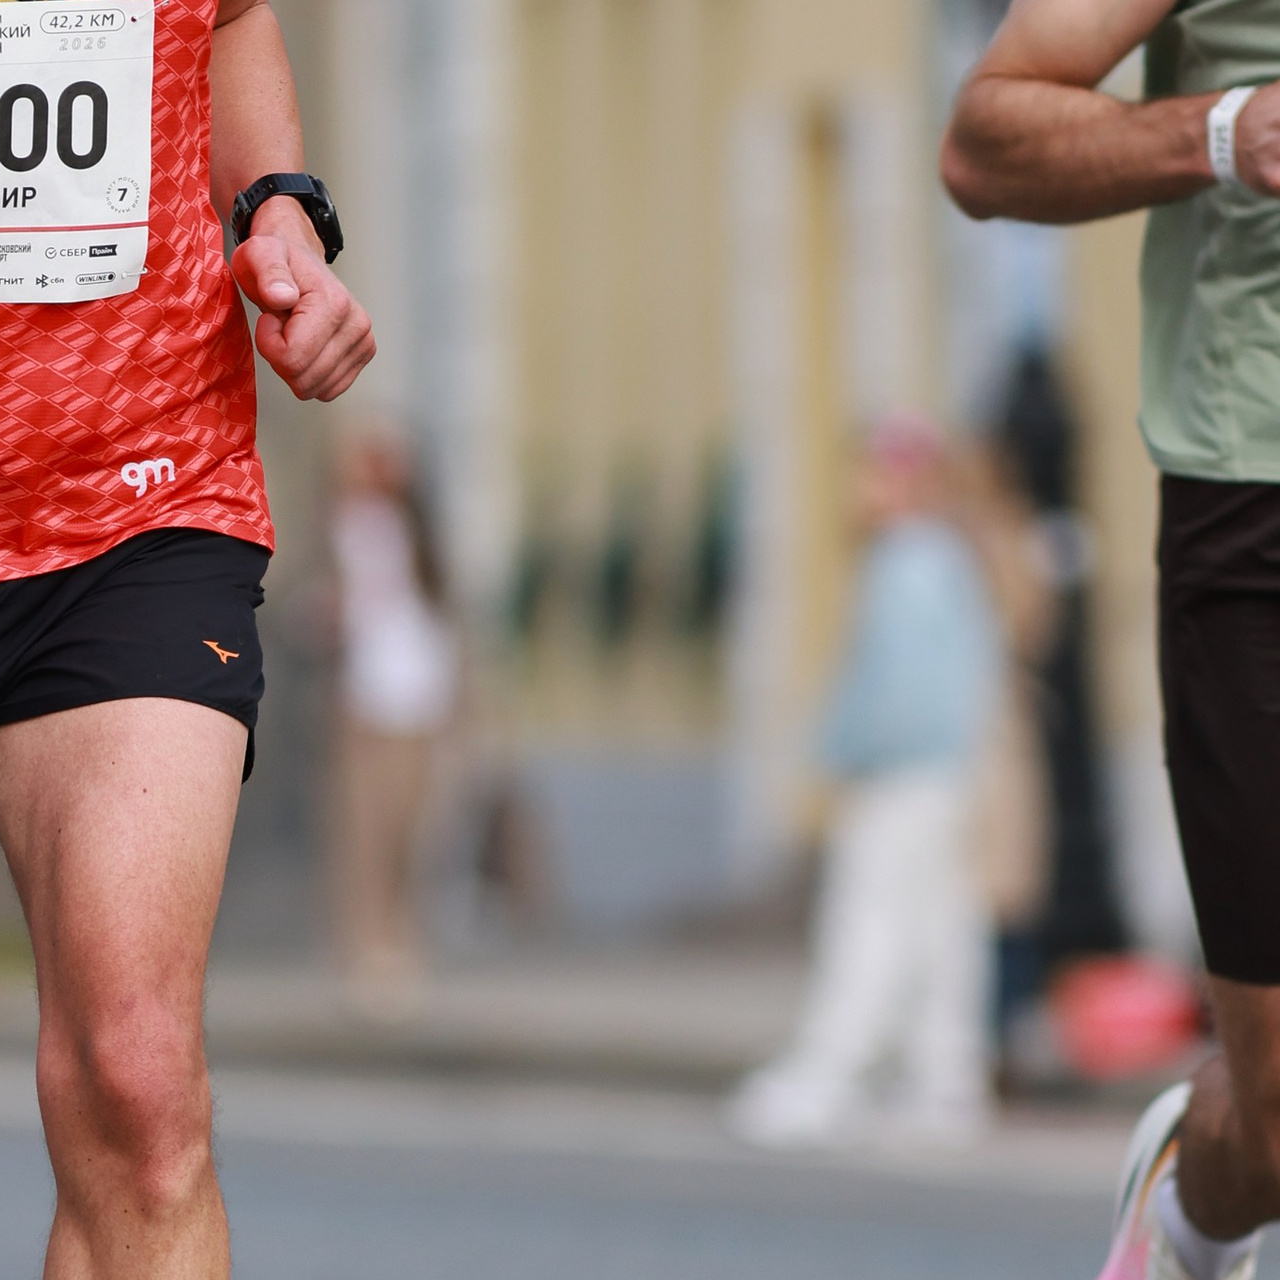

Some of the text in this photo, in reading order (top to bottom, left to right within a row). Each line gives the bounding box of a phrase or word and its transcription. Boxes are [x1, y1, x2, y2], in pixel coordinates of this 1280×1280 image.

[49, 14, 84, 30] 42,2
[58, 36, 107, 51] 2026
[117, 187, 128, 202] 7
[59, 246, 113, 257] СБЕР Прайм
[78, 274, 108, 283] WINLINE
